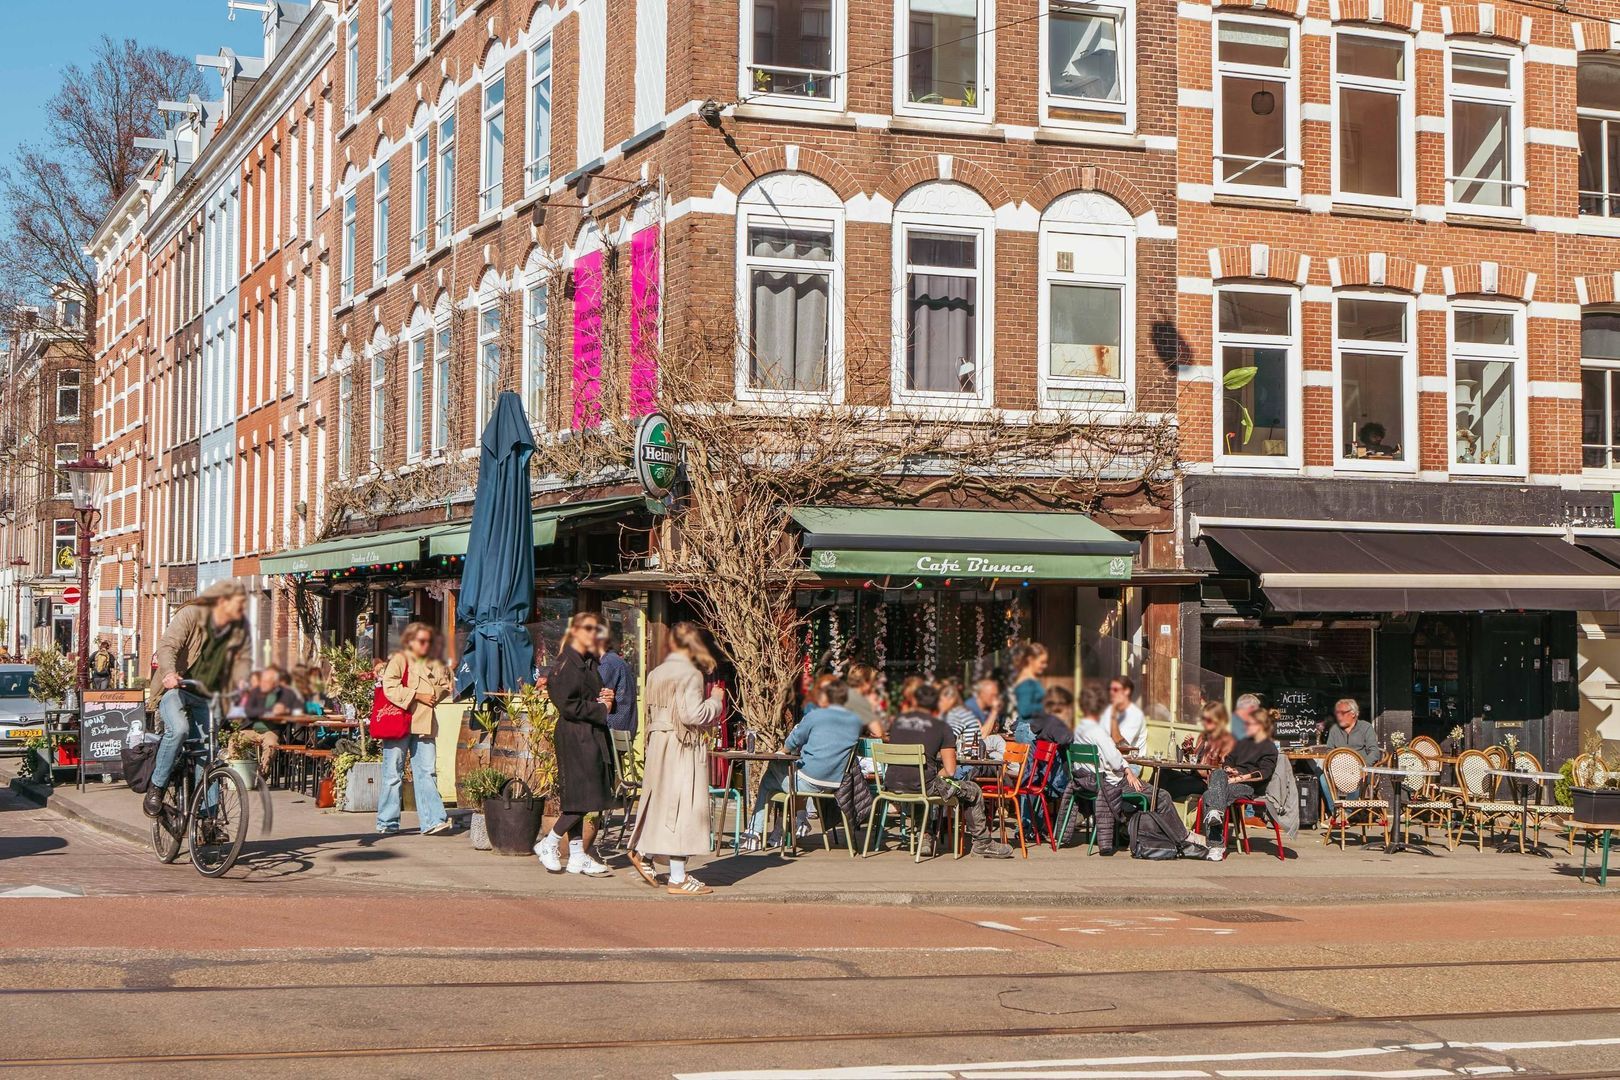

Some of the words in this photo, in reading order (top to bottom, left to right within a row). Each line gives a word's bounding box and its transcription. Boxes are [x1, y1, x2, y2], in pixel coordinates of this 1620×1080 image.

[916, 556, 961, 574] Café
[967, 557, 1035, 573] Binnen
[1282, 694, 1307, 704] ACTIE
